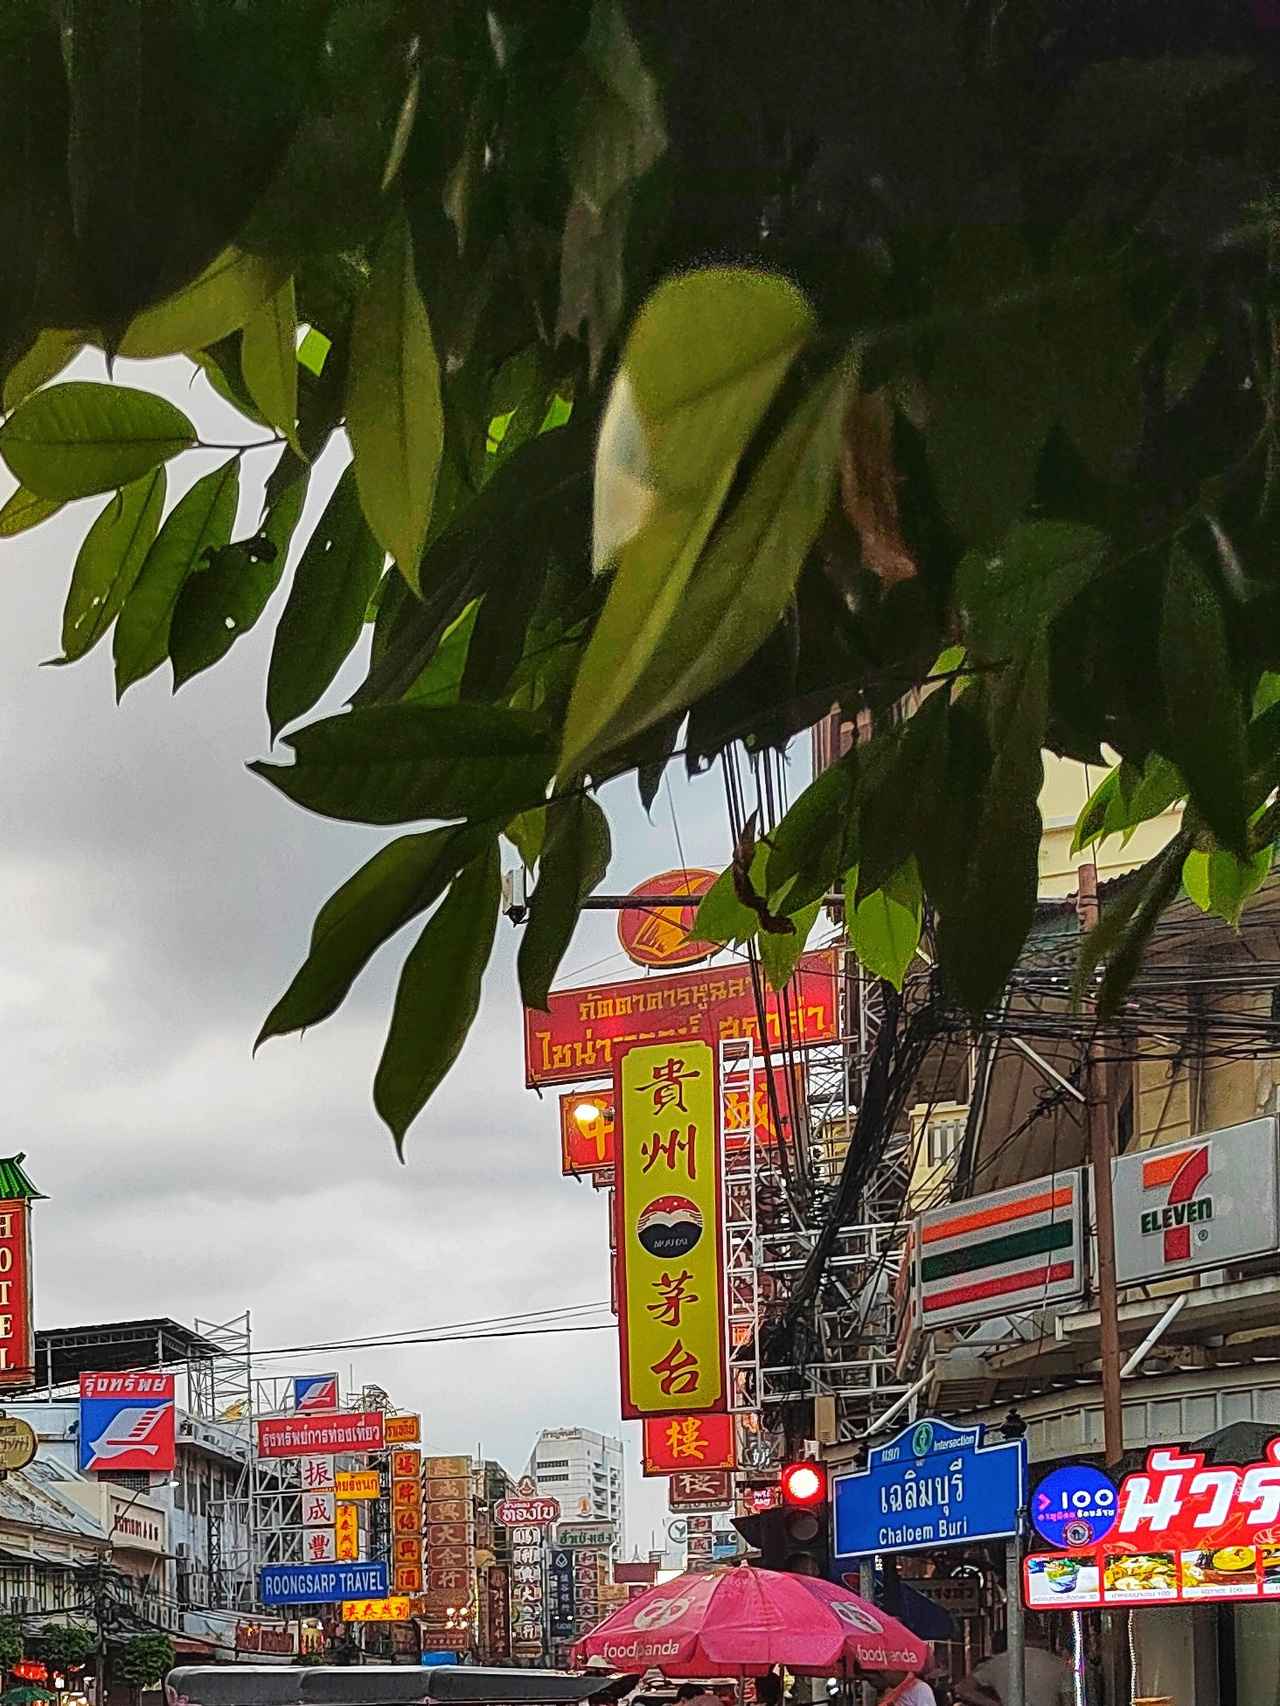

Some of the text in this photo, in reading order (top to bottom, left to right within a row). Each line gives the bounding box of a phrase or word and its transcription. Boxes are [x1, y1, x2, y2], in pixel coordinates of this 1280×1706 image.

[1143, 1145, 1209, 1263] 7
[634, 1058, 701, 1396] 貴州茅台
[85, 1374, 169, 1398] รุ่งทรัพย์
[262, 1415, 380, 1455] รุ่งทรัพย์การท่องเที่ยว
[933, 1434, 974, 1452] Intersection
[881, 1457, 964, 1517] เฉลิมบุรี
[303, 1460, 333, 1561] 振成豐
[502, 1501, 554, 1521] ทองใบ
[879, 1515, 968, 1546] Chaloem Buri
[265, 1571, 384, 1596] ROONGSARP TRAVEL
[603, 1638, 680, 1660] foodpanda
